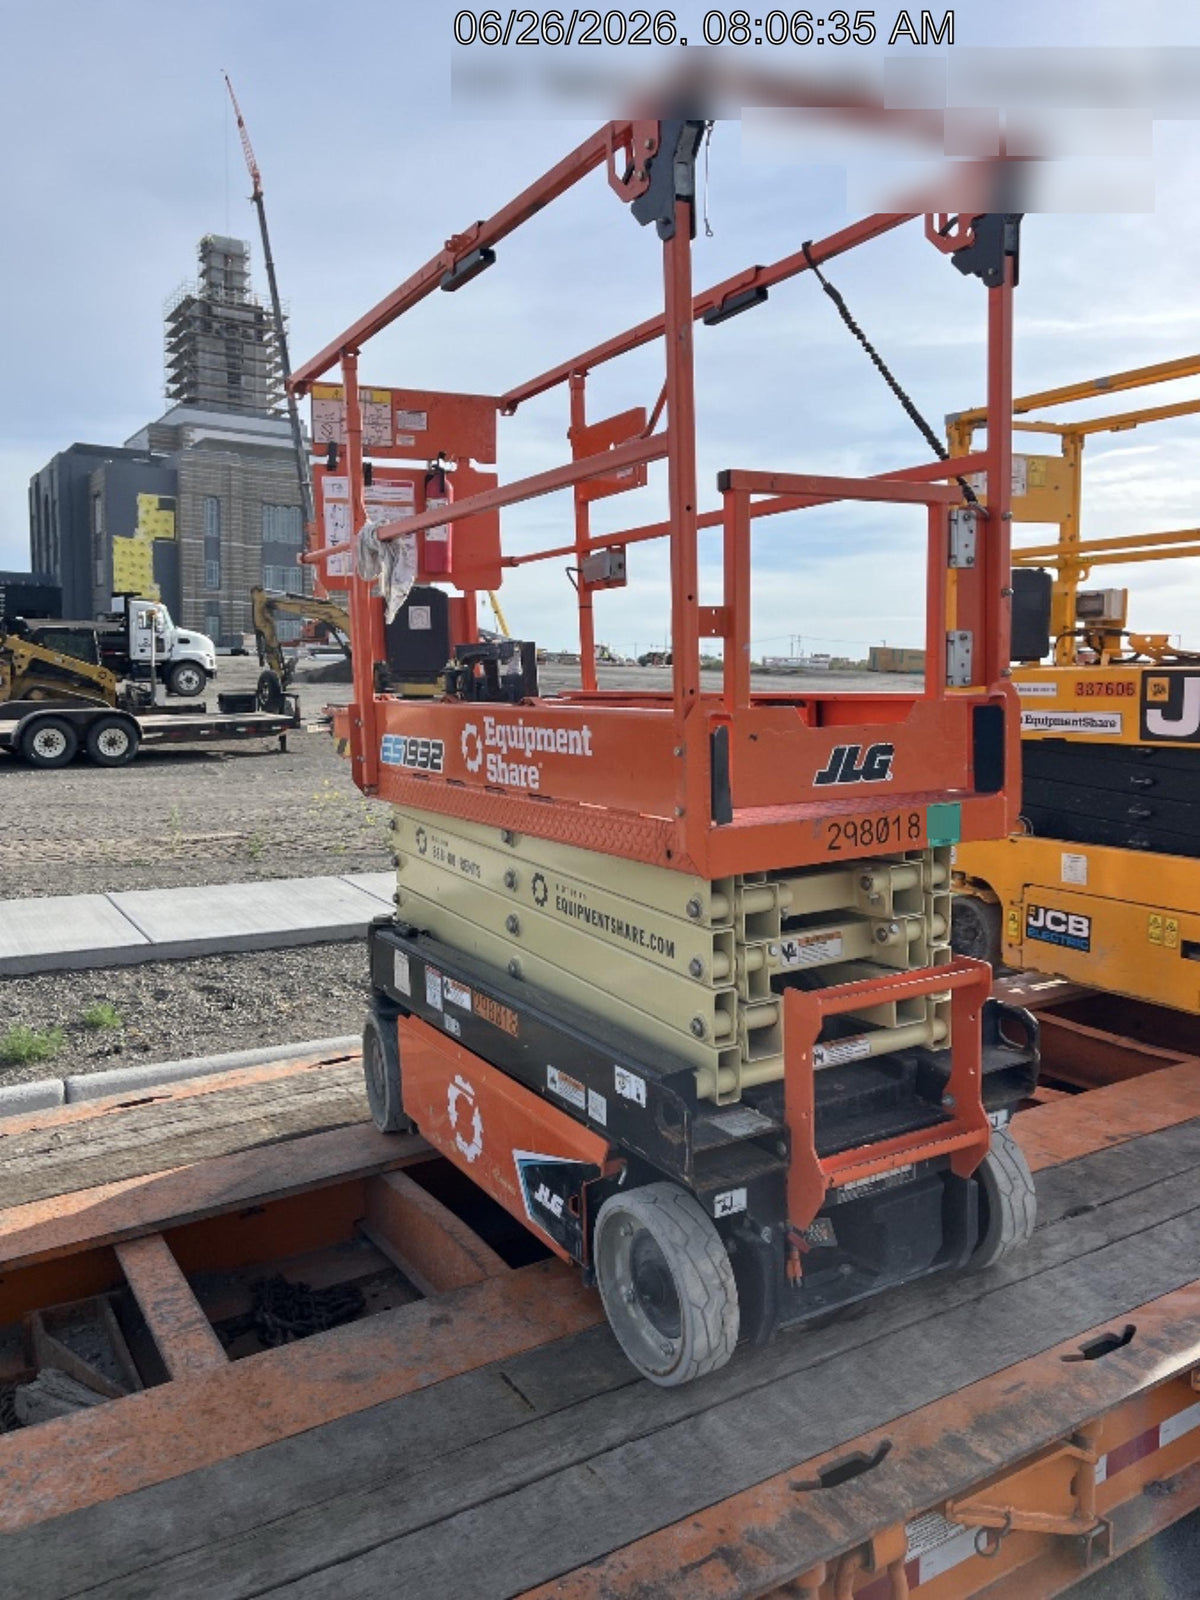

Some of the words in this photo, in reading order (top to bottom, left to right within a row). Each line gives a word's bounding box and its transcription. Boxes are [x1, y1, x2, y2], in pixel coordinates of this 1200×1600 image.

[483, 716, 592, 757] Equipment
[1025, 714, 1117, 728] EquipmentShare
[486, 753, 540, 789] Share
[813, 743, 894, 786] JLG
[827, 812, 920, 850] 298018
[556, 895, 675, 959] EQUIPMENTSHARE.COM
[1028, 907, 1089, 938] JCB
[534, 1182, 564, 1218] JLG
